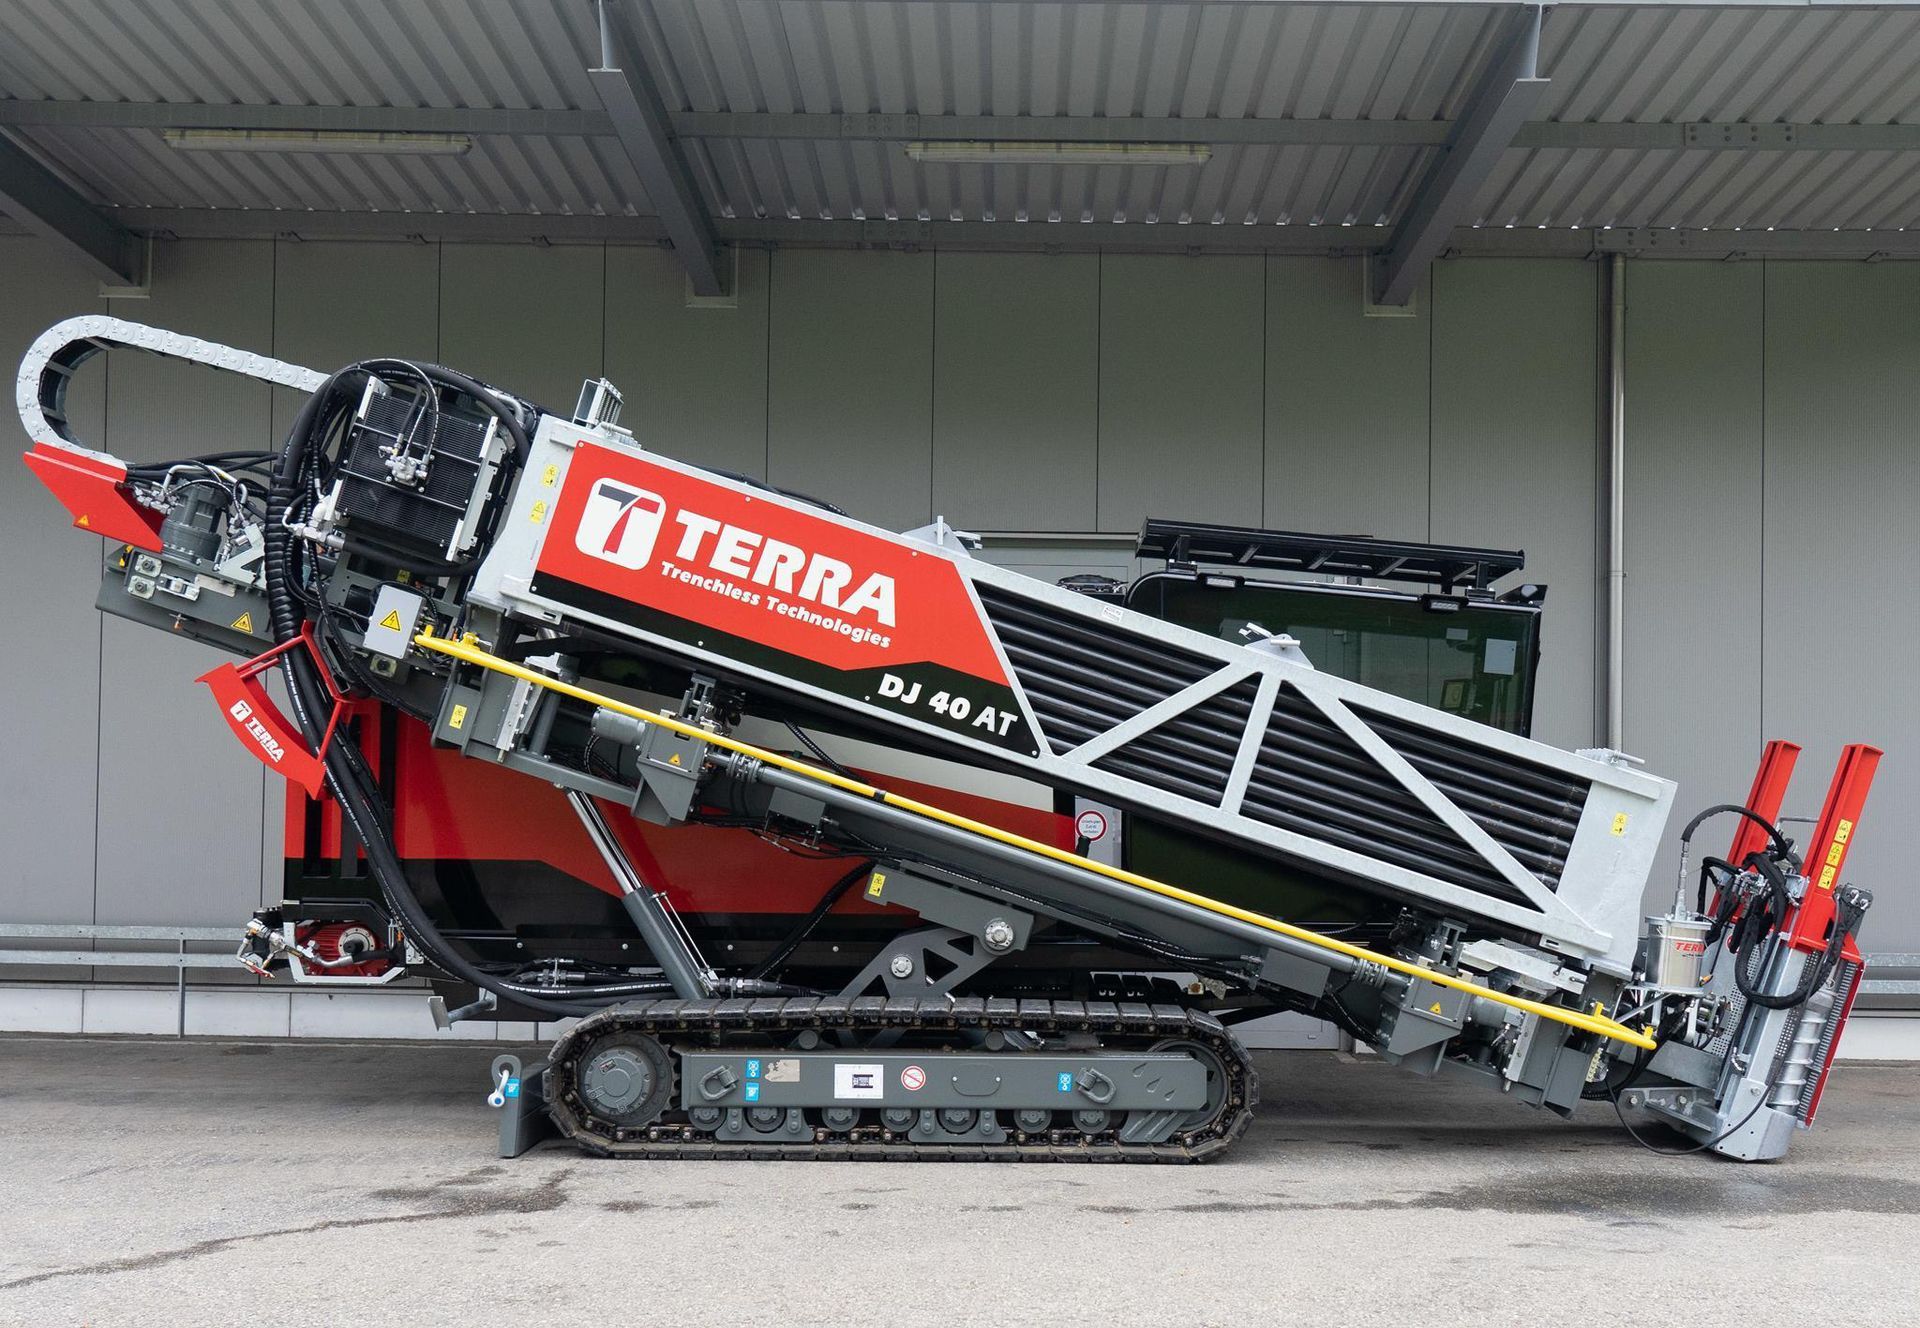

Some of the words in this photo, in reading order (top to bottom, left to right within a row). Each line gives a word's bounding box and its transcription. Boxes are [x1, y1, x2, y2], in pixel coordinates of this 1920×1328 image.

[661, 560, 761, 606] Trenchless
[766, 596, 891, 648] Technologies
[675, 509, 896, 628] TERRA
[248, 716, 285, 761] TERRA
[877, 673, 923, 704] DJ
[928, 690, 971, 720] 40
[971, 705, 1018, 737] AT
